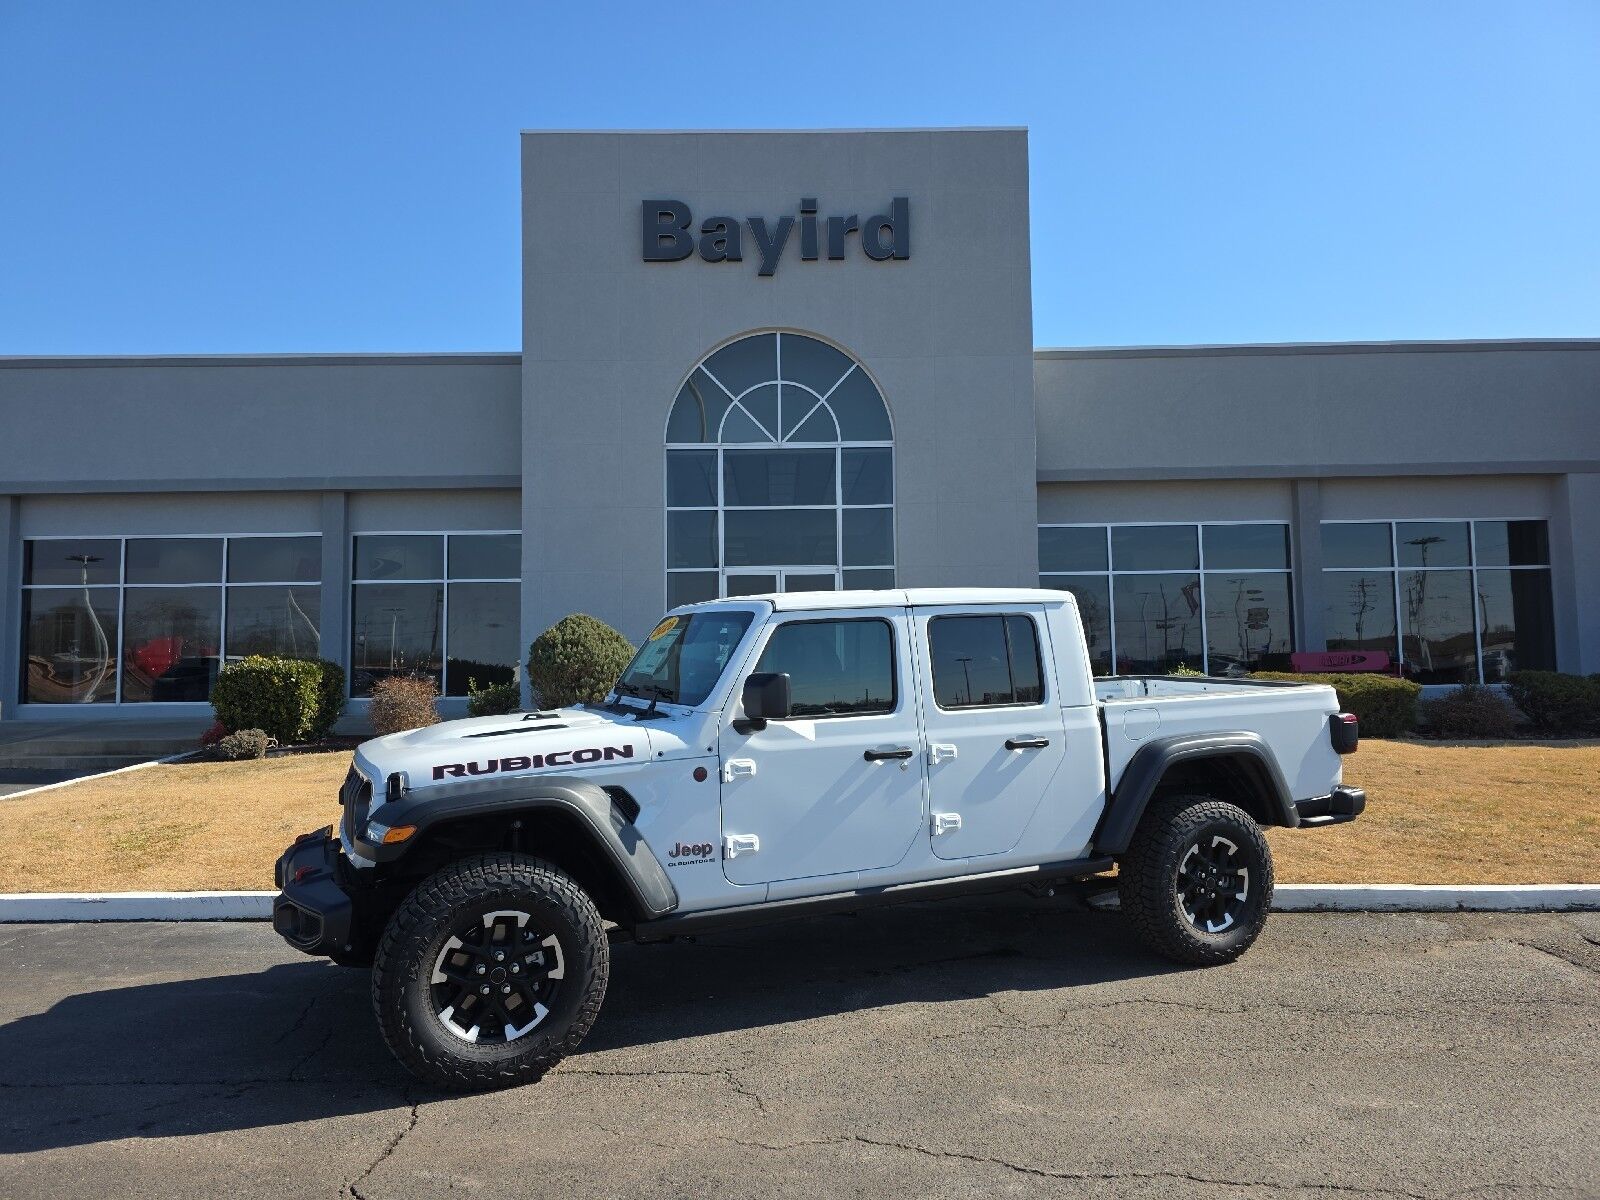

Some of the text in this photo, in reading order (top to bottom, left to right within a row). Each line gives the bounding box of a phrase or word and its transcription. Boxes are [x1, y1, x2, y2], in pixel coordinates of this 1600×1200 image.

[642, 197, 910, 276] Bayird
[432, 744, 634, 780] RUBICON
[667, 858, 709, 867] GLADIATOR
[668, 842, 713, 858] Jeep
